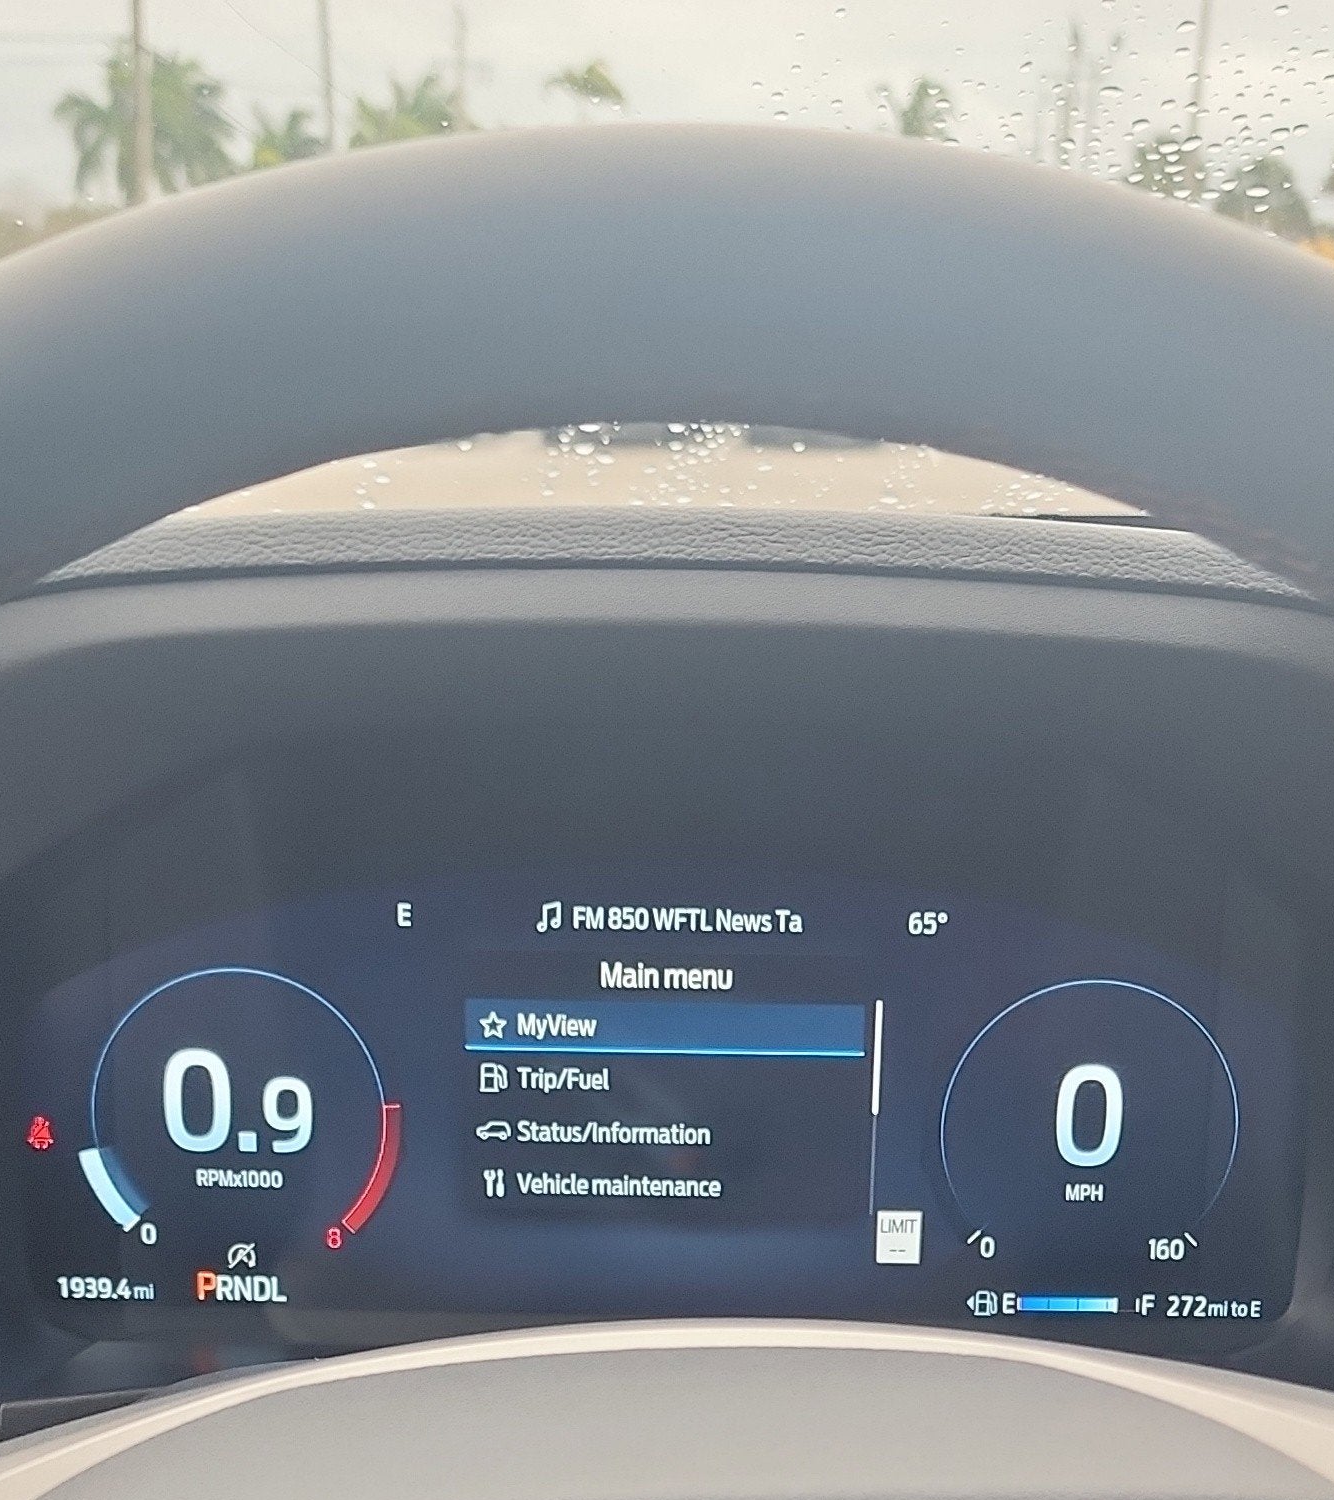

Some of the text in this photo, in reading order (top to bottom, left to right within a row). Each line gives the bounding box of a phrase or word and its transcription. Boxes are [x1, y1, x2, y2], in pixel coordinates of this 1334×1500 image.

[396, 902, 413, 928] E
[572, 907, 803, 933] FM 850 WFTL News Ta
[599, 962, 733, 991] Main menu
[517, 1013, 597, 1039] MyView
[517, 1066, 609, 1093] Trip/Fuel
[163, 1047, 314, 1153] 0.9
[1055, 1063, 1123, 1167] 0
[517, 1120, 711, 1147] Status/Information
[196, 1169, 283, 1190] RPMx1000
[516, 1173, 721, 1199] Vehicle maintenance
[1065, 1184, 1104, 1202] MPH
[140, 1223, 158, 1245] 0
[326, 1227, 342, 1249] 8
[880, 1218, 917, 1235] LIMIT
[980, 1237, 995, 1258] 0
[1148, 1239, 1185, 1261] 160
[57, 1276, 132, 1300] 1939.4
[1002, 1293, 1016, 1314] E
[1142, 1294, 1156, 1316] F
[1166, 1295, 1207, 1318] 272
[1230, 1303, 1248, 1318] to
[1250, 1301, 1262, 1318] E
